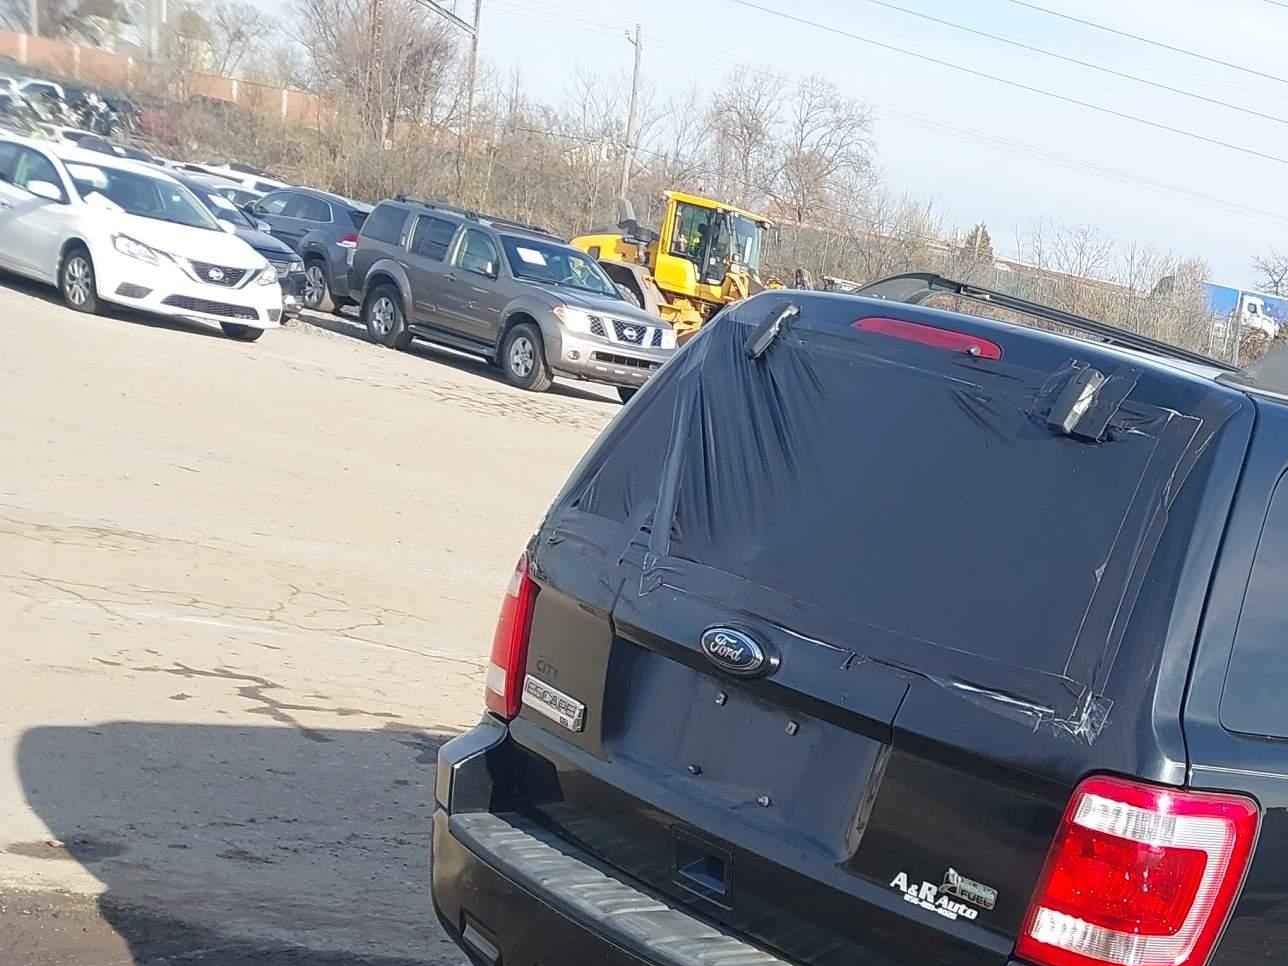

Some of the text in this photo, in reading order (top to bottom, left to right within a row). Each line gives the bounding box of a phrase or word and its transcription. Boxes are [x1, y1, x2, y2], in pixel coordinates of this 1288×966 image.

[710, 633, 744, 662] Ford
[527, 682, 577, 719] ESCAPE
[889, 871, 938, 903] A&R
[935, 895, 978, 920] Auto
[961, 890, 993, 908] FUEL
